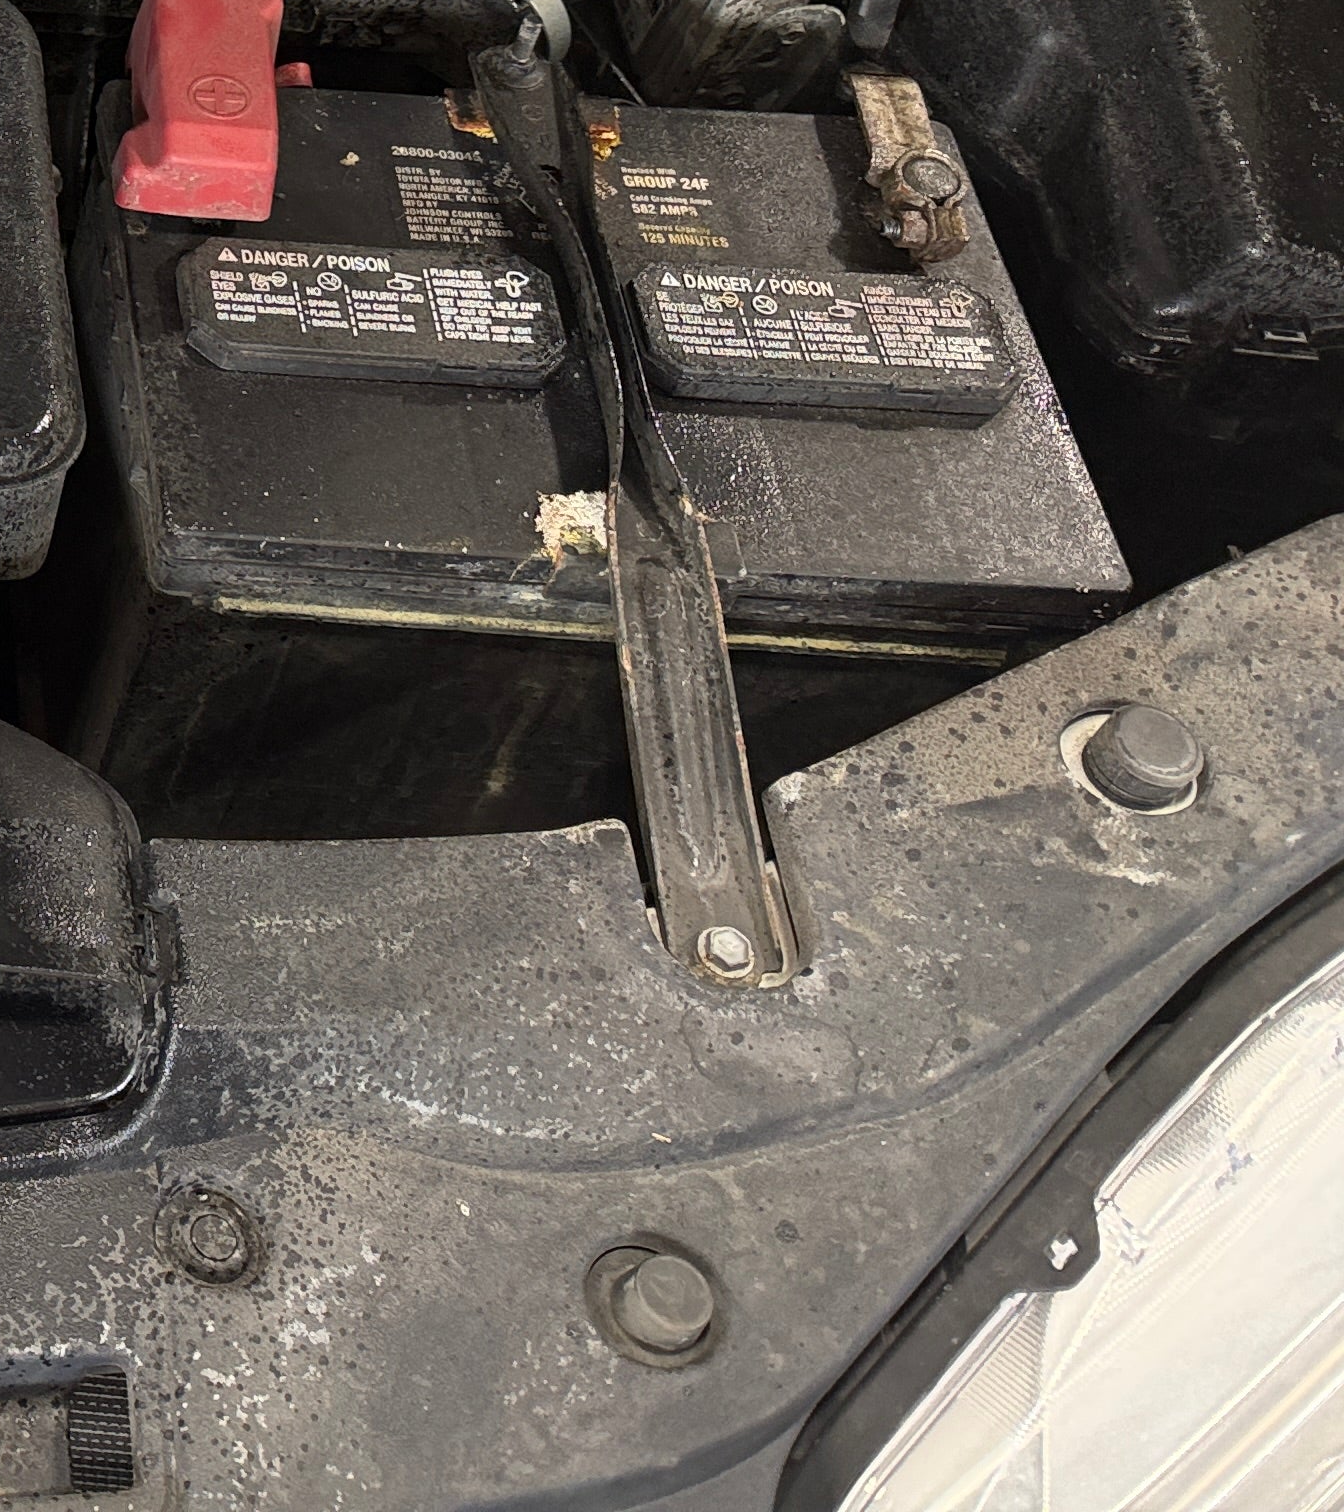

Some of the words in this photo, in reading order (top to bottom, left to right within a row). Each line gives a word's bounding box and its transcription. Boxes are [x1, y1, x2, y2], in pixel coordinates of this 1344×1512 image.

[397, 175, 430, 184] TOYOTA
[622, 175, 676, 188] GROUP
[680, 177, 710, 191] 24F
[404, 207, 449, 217] JOHNSON
[659, 204, 699, 217] AMPS
[668, 233, 730, 248] MINUTES
[240, 249, 310, 268] DANGER
[326, 254, 391, 273] POISON
[211, 280, 236, 291] EYES
[305, 286, 322, 297] NO
[683, 273, 753, 293] DANGER
[769, 278, 835, 297] POISON
[213, 290, 263, 304] EXPLOSIVE
[264, 294, 296, 306] GASES
[351, 289, 400, 302] SULFURIC
[400, 292, 425, 304] ACID
